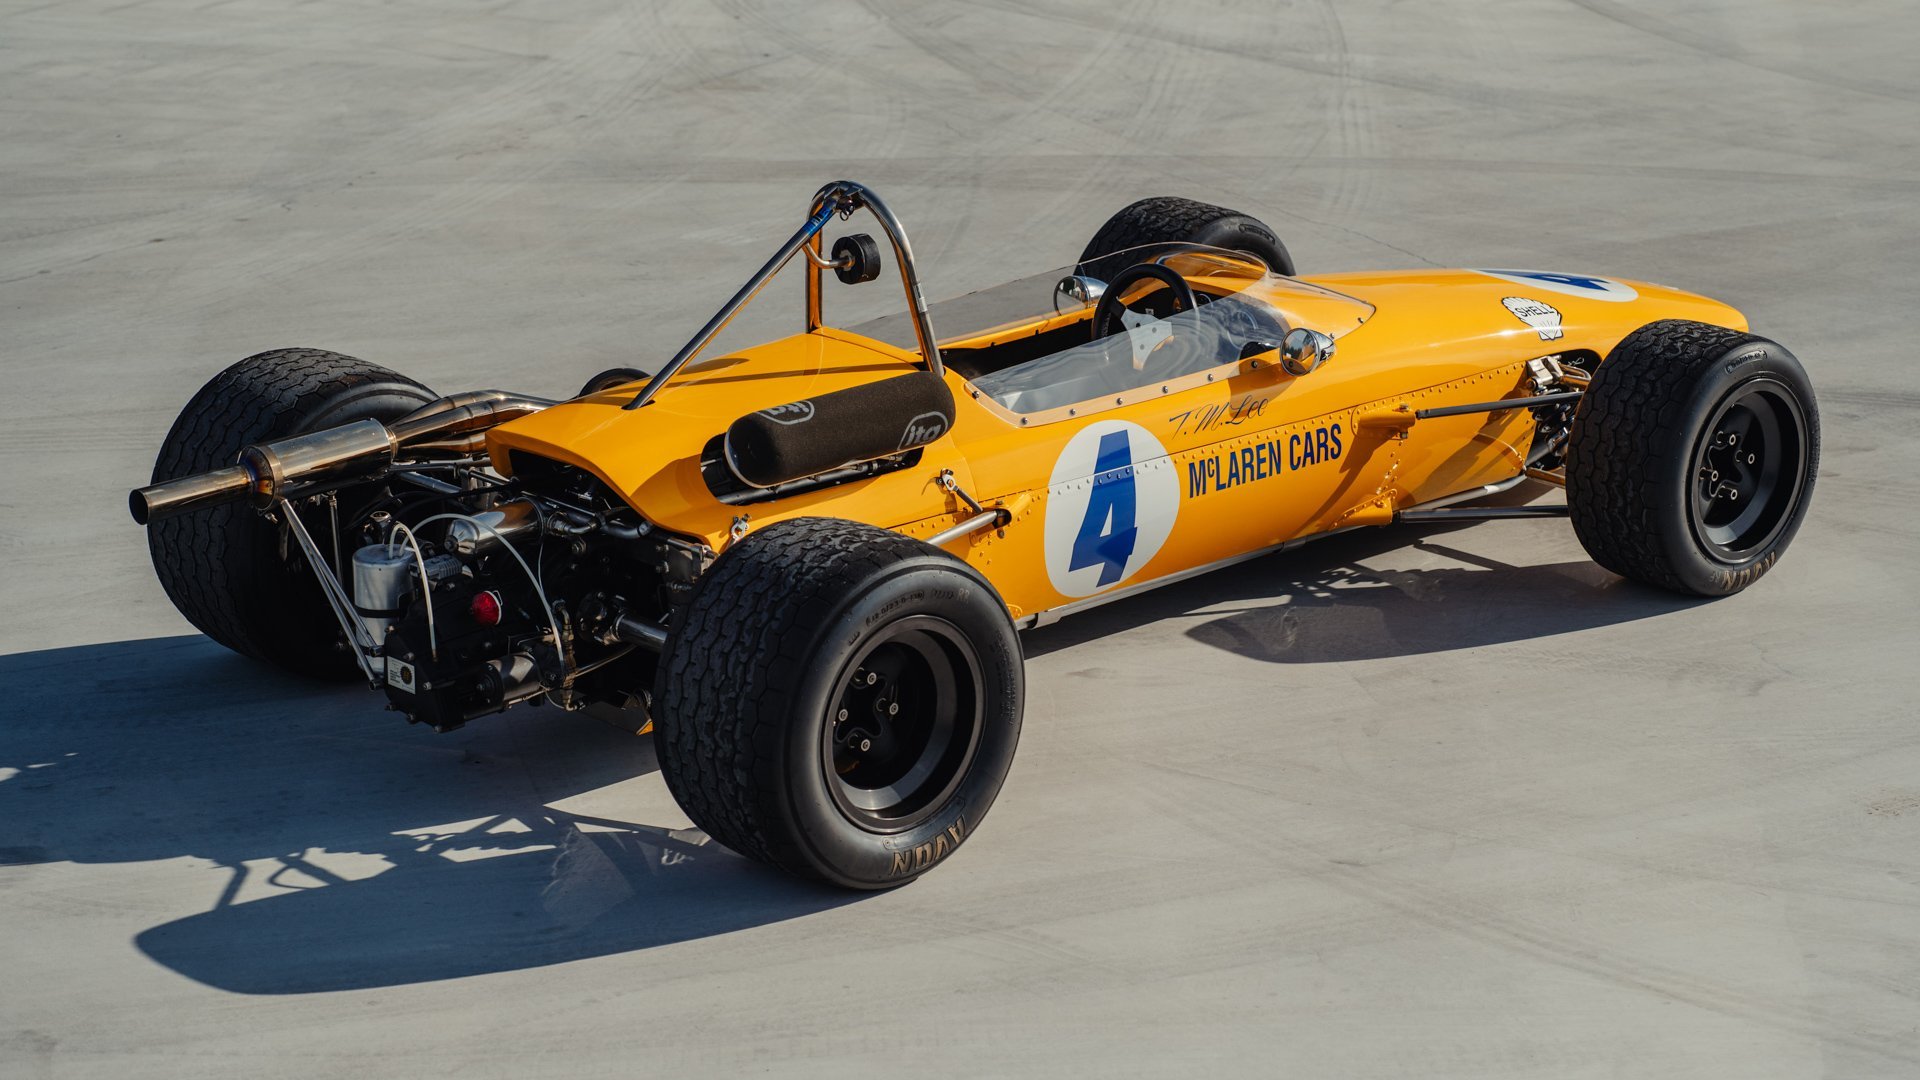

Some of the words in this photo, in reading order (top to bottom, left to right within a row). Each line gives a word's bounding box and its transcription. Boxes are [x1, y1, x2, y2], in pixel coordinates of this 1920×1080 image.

[1514, 305, 1555, 318] SHELL
[1289, 422, 1343, 472] CARS
[1068, 429, 1138, 588] 4
[1720, 550, 1777, 592] AVON
[889, 814, 967, 877] AVON
